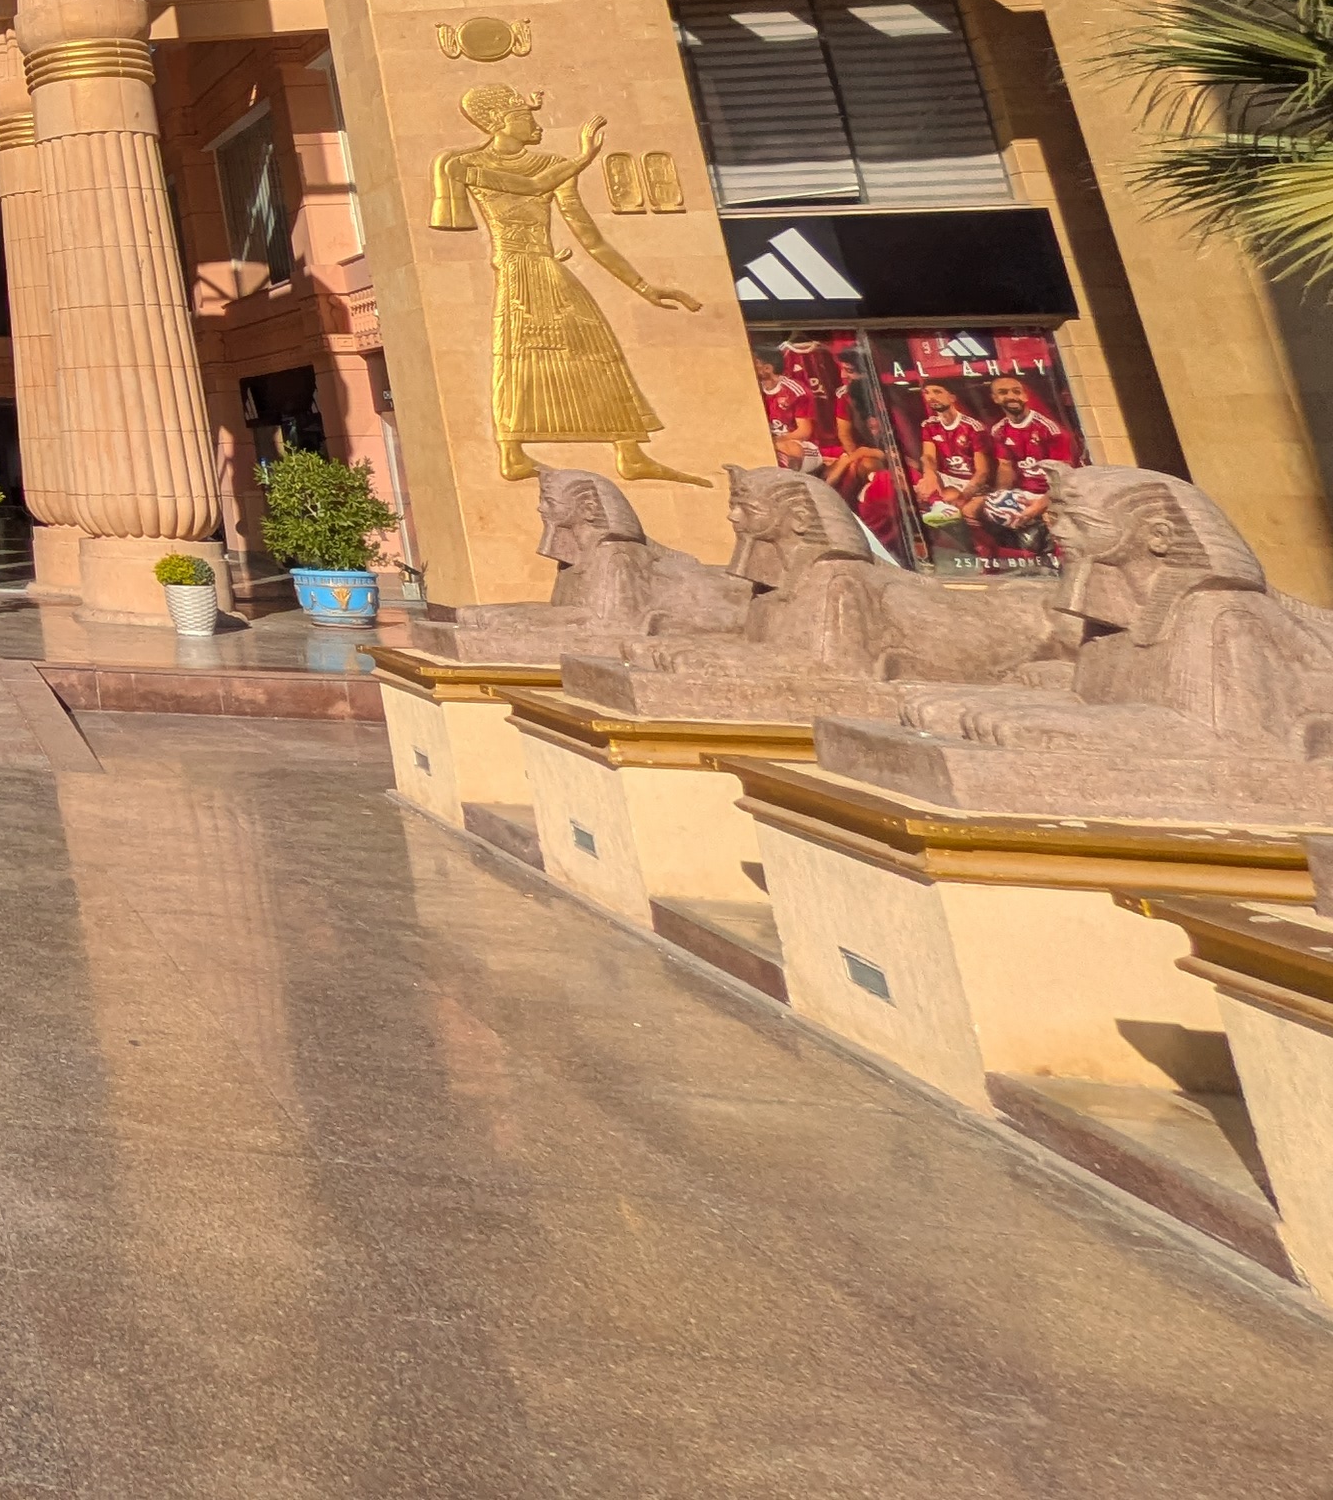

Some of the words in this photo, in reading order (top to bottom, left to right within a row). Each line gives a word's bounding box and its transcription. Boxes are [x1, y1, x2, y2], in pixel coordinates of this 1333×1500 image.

[893, 360, 930, 378] AL
[962, 358, 1046, 378] AHLY
[953, 557, 1001, 569] 25/26
